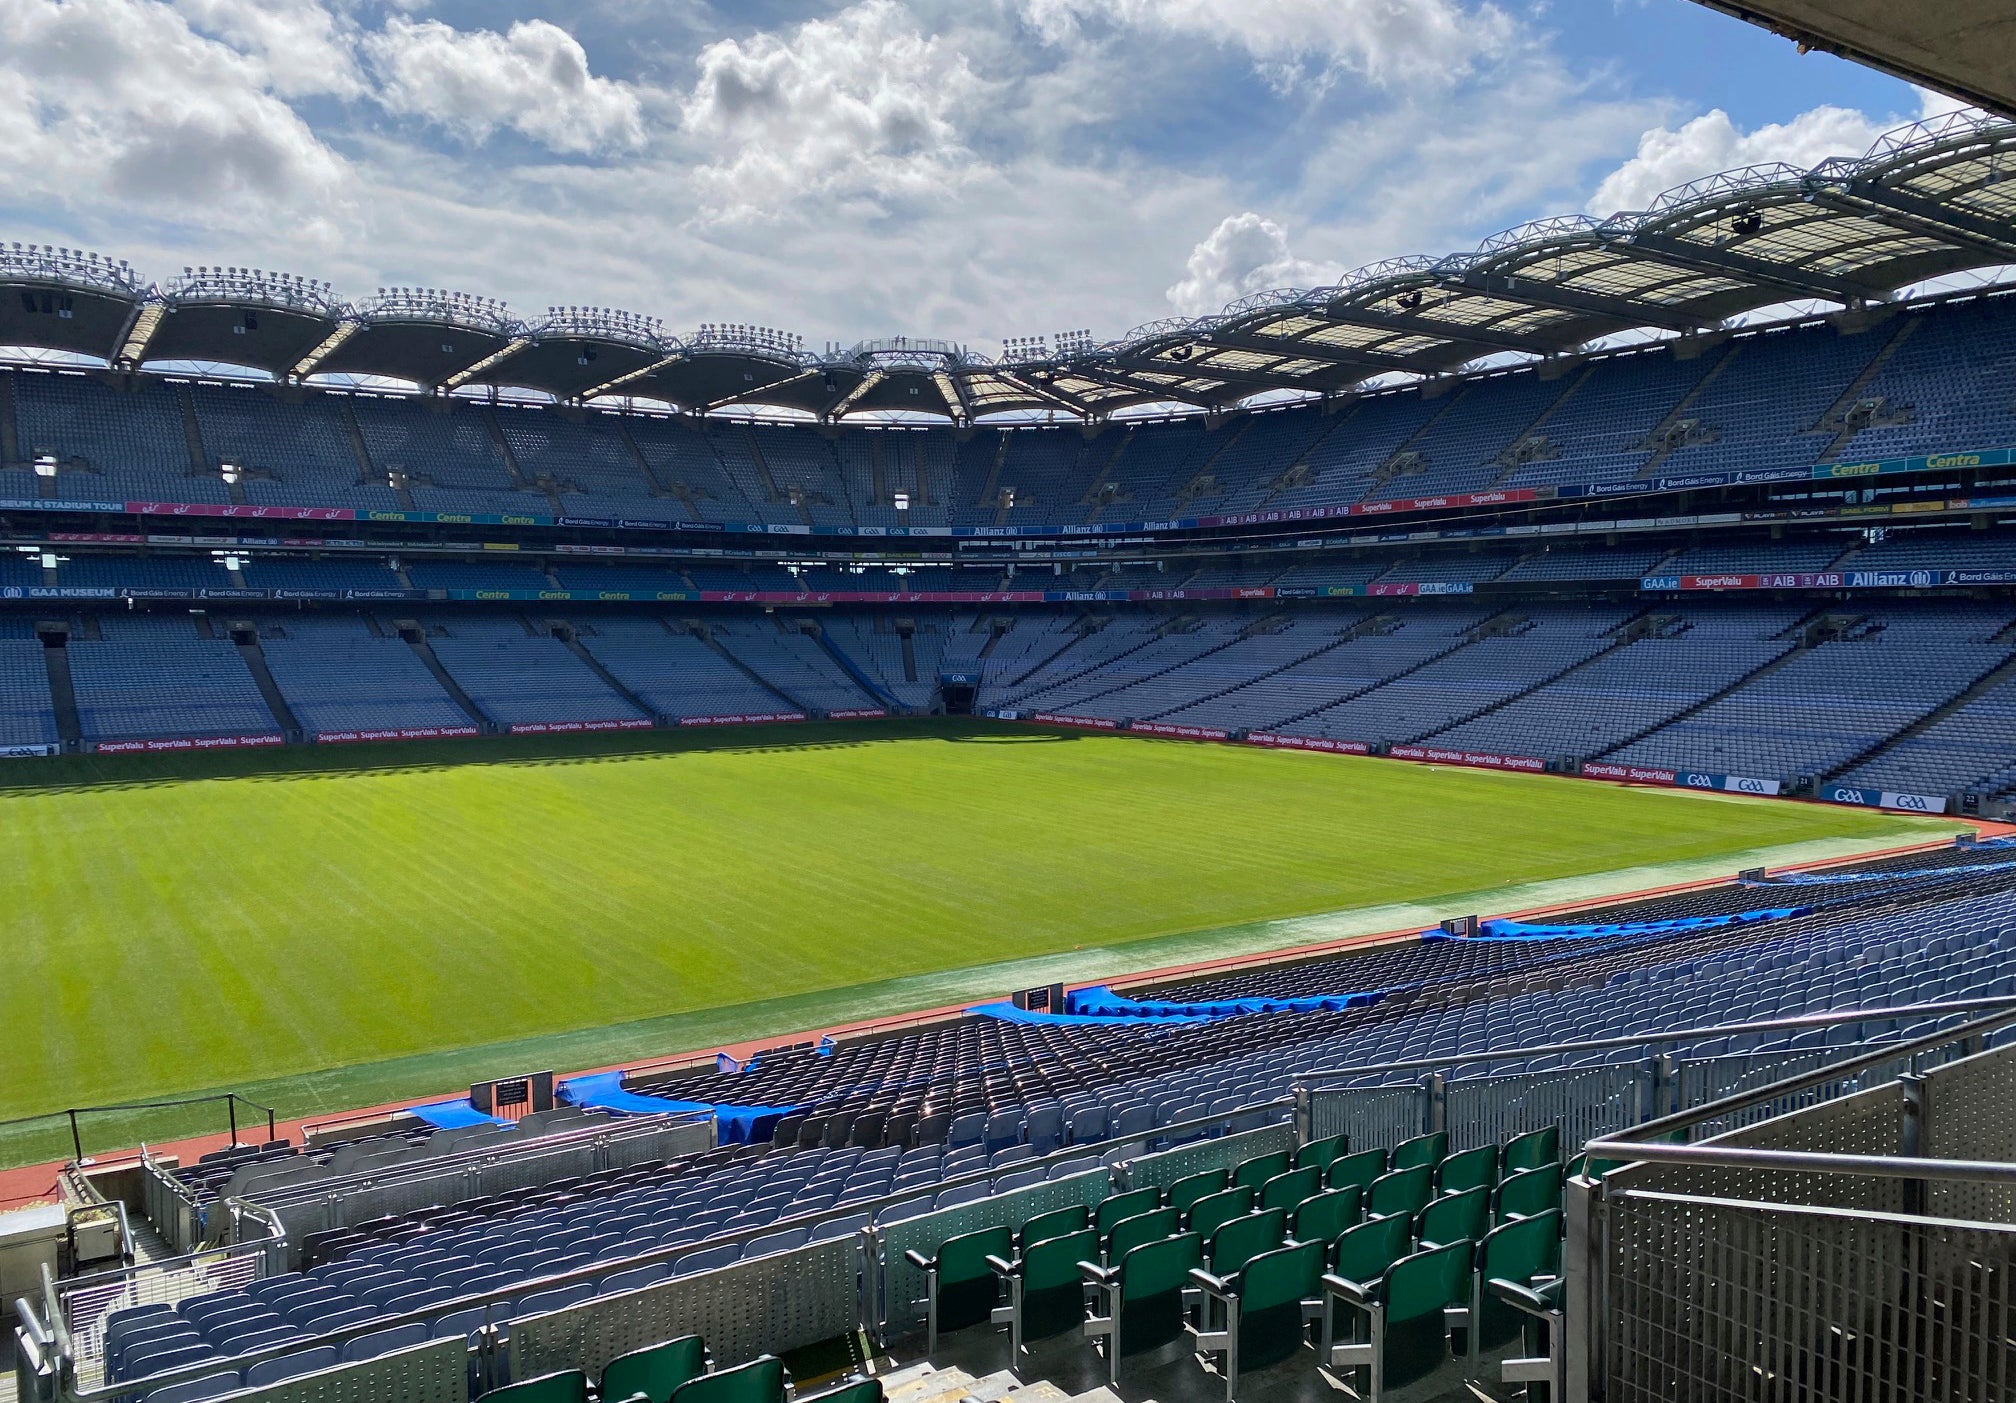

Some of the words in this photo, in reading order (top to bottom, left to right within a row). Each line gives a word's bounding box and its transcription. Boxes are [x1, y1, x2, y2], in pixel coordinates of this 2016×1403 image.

[1926, 454, 1980, 468] Centra
[1831, 463, 1880, 476] Centra
[1700, 476, 1724, 485] Energy
[1626, 483, 1648, 492] Energy
[1414, 498, 1446, 508] SuperValu
[1470, 494, 1506, 504] SuperValu
[44, 501, 92, 510] STADIUM
[94, 502, 123, 511] TOUR
[1336, 506, 1348, 515] AIB
[1362, 504, 1392, 512] SuperValu
[368, 511, 405, 520] Centra
[1266, 512, 1280, 520] AIB
[1289, 510, 1302, 518] AIB
[1312, 508, 1324, 516] AIB
[437, 513, 472, 522] Centra
[502, 515, 535, 524] Centra
[1062, 526, 1091, 534] Allianz
[1143, 521, 1168, 530] Allianz
[974, 528, 1004, 536] Allianz
[1816, 574, 1838, 586] AIB
[1852, 571, 1907, 585] Allianz
[1982, 572, 2004, 580] Gáis
[1644, 578, 1678, 588] GAA.ie
[1696, 576, 1742, 588] SuperValu
[1773, 576, 1795, 586] AIB
[30, 588, 58, 597] GAA
[60, 588, 114, 597] MUSEUM
[476, 591, 510, 600] Centra
[1240, 589, 1266, 597] SuperValu
[1328, 587, 1354, 595] Centra
[538, 592, 571, 600] Centra
[599, 592, 630, 600] Centra
[656, 592, 686, 600] Centra
[1065, 592, 1094, 600] Allianz
[681, 717, 712, 725] SuperValu
[746, 714, 774, 722] SuperValu
[776, 712, 804, 720] SuperValu
[512, 724, 546, 732] SuperValu
[550, 722, 582, 732] SuperValu
[584, 721, 618, 730] SuperValu
[620, 720, 652, 728] SuperValu
[1131, 722, 1152, 732] SuperValu
[1154, 724, 1176, 733] SuperValu
[1177, 727, 1200, 736] SuperValu
[1202, 729, 1225, 738] SuperValu
[318, 732, 358, 742] SuperValu
[360, 730, 398, 740] SuperValu
[401, 729, 438, 738] SuperValu
[441, 727, 476, 736] SuperValu
[100, 742, 144, 752] SuperValu
[148, 740, 191, 750] SuperValu
[195, 738, 237, 748] SuperValu
[240, 736, 281, 745] SuperValu
[1248, 734, 1275, 744] SuperValu
[1276, 736, 1304, 746] SuperValu
[1305, 738, 1334, 750] SuperValu
[1336, 742, 1367, 752] SuperValu
[1391, 746, 1425, 758] SuperValu
[1427, 750, 1463, 762] SuperValu
[1464, 753, 1502, 766] SuperValu
[1504, 756, 1543, 770] SuperValu
[1584, 763, 1627, 776] SuperValu
[1629, 768, 1675, 782] SuperValu
[1687, 774, 1712, 788] GAA
[1738, 778, 1765, 792] GAA
[1834, 788, 1865, 804] GAA
[1966, 794, 1975, 802] 22
[1896, 794, 1928, 810] GAA
